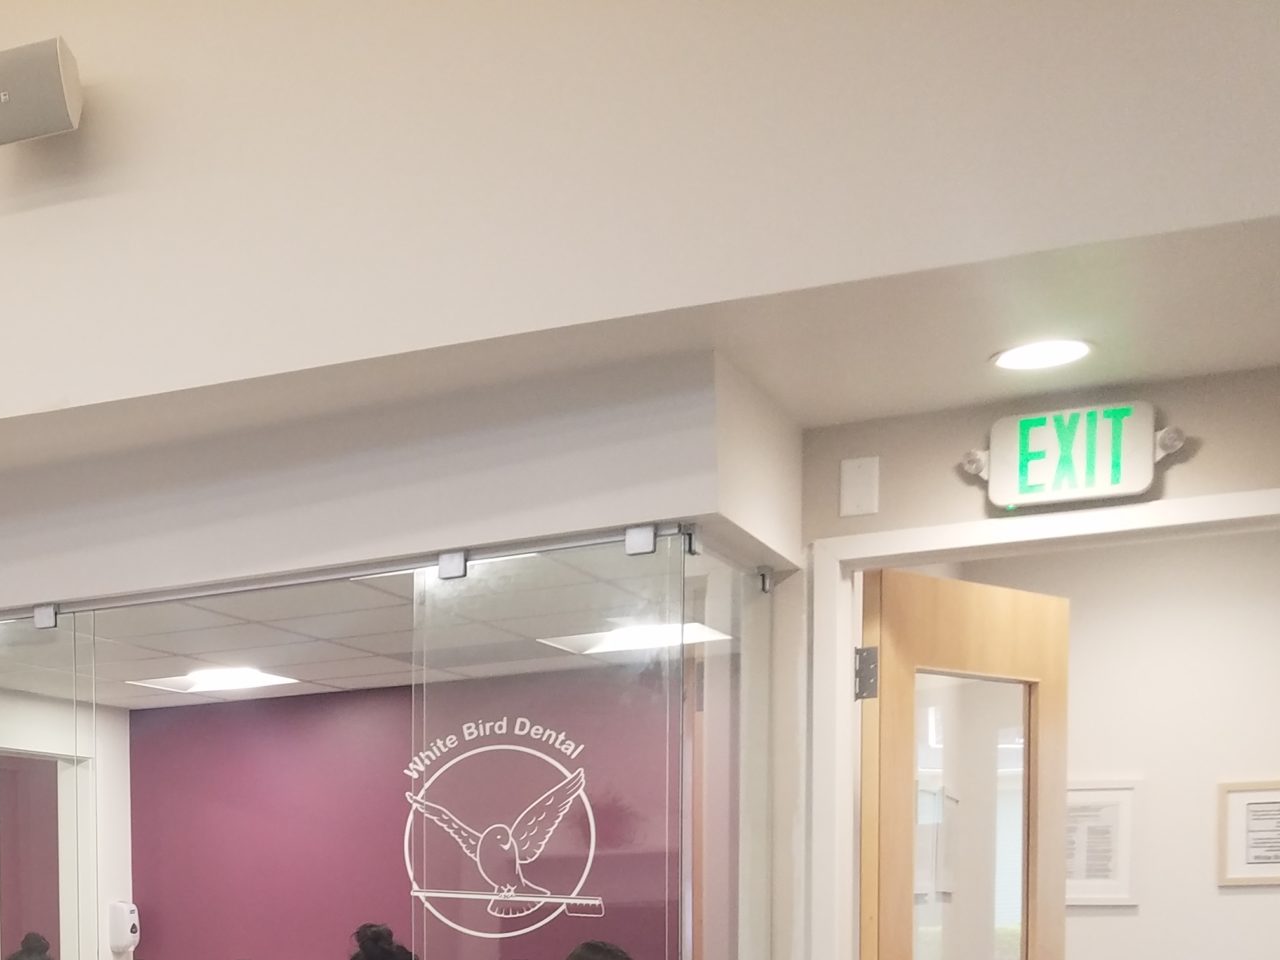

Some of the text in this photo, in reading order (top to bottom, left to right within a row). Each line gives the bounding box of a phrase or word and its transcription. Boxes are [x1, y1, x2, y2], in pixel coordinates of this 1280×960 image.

[1018, 405, 1134, 495] EXIT
[403, 716, 585, 780] White Bird Dental
